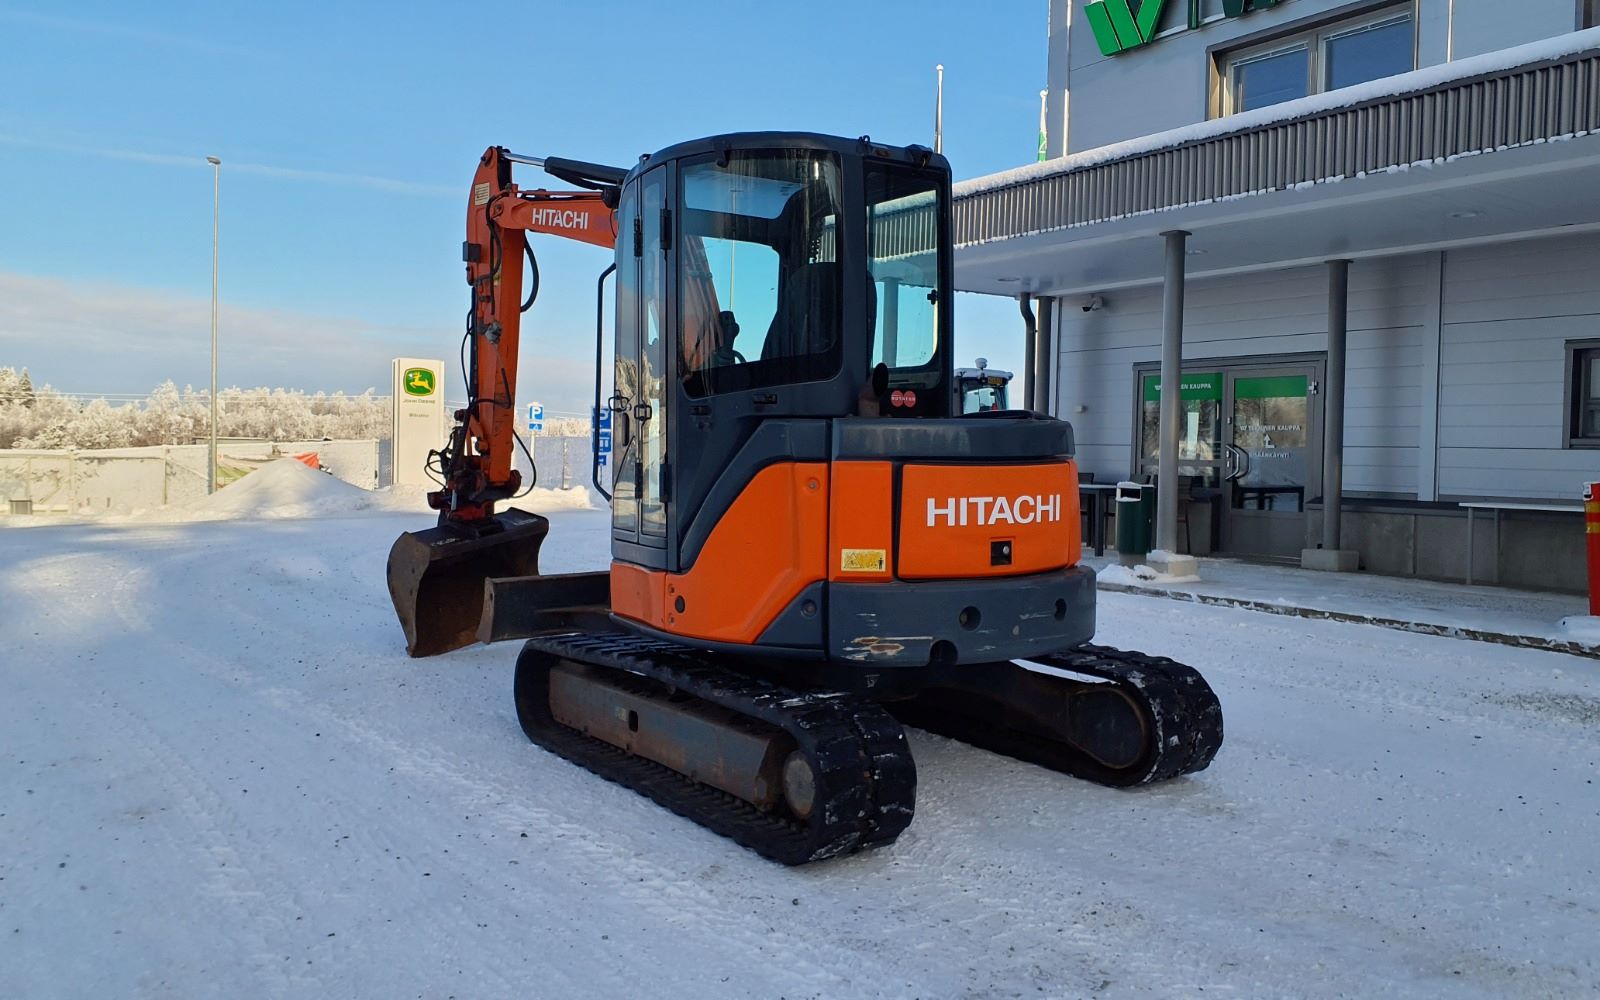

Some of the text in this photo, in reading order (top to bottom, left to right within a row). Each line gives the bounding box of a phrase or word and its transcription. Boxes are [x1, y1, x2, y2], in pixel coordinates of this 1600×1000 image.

[532, 208, 589, 230] HITACHI
[532, 406, 541, 419] P
[1277, 424, 1301, 432] KAUPPA
[926, 493, 1061, 528] HITACHI
